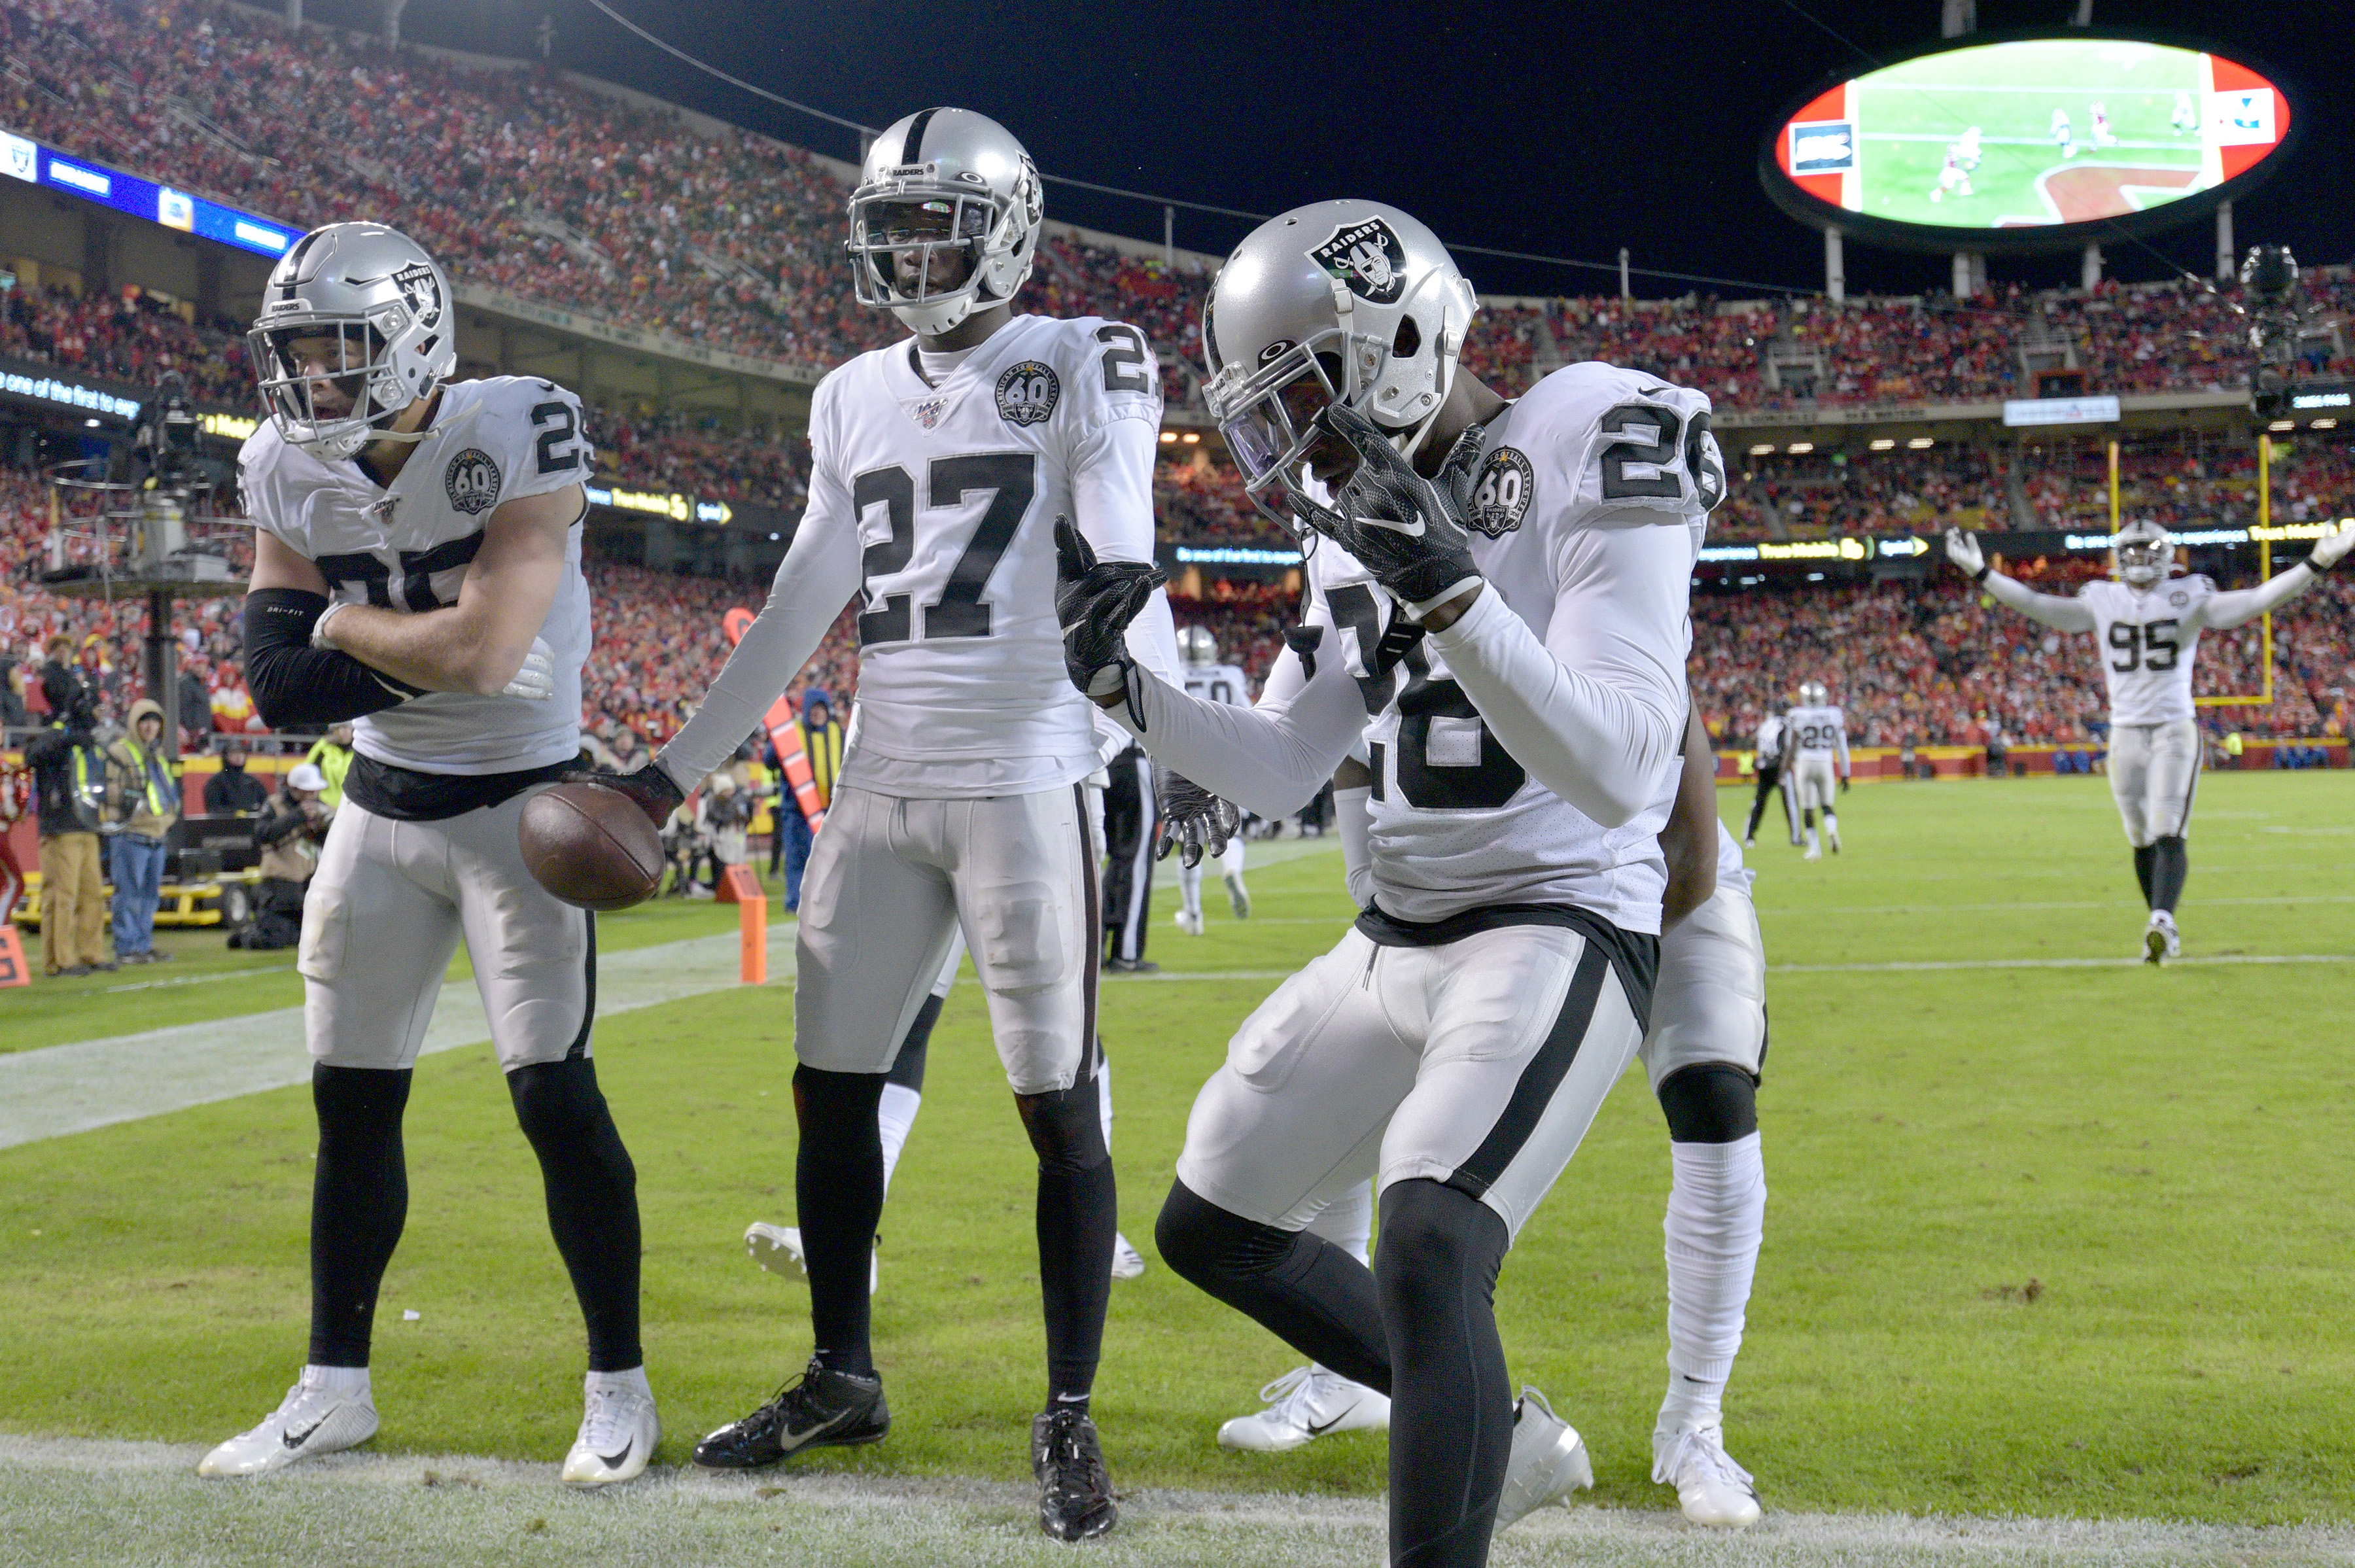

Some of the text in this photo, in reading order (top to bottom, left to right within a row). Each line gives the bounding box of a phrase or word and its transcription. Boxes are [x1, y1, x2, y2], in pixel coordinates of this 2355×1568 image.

[1320, 222, 1380, 258] RAIDERS
[396, 266, 430, 281] RAIDERS
[271, 303, 300, 312] RAIDERS
[6, 374, 34, 395] one
[34, 377, 50, 398] of
[50, 380, 73, 404] the
[99, 392, 114, 412] to
[1005, 376, 1049, 406] 60
[1601, 406, 1724, 512] 26
[455, 464, 491, 497] 60
[1474, 469, 1522, 510] 60
[1517, 470, 1530, 513] LEAGUE
[853, 453, 1036, 646] 27
[266, 606, 304, 617] DRI-FIT
[2109, 619, 2179, 672] 95
